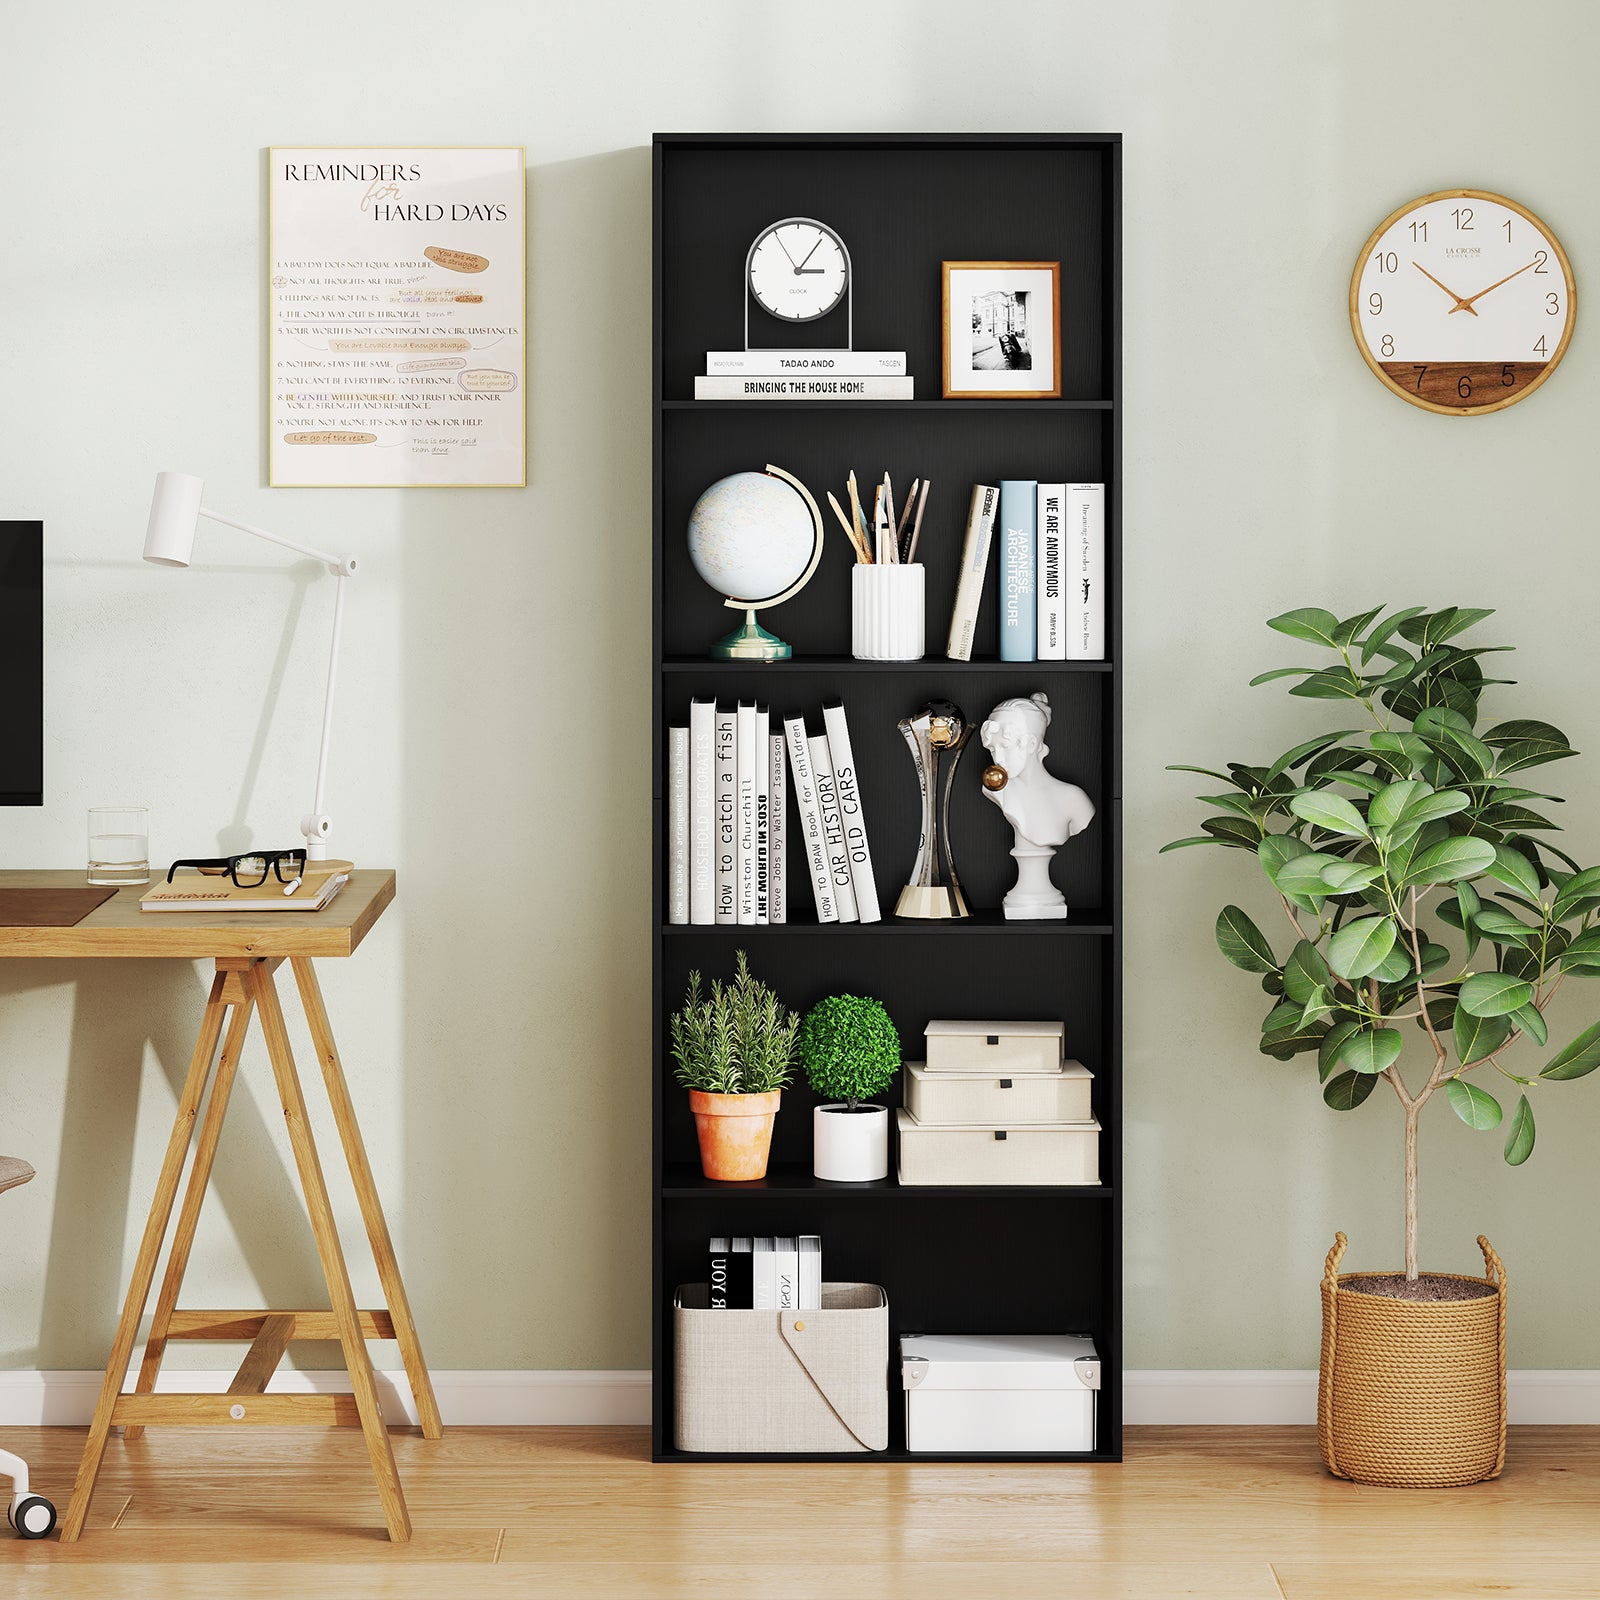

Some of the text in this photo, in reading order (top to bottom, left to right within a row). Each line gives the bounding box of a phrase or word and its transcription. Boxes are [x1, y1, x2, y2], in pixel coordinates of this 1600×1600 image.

[284, 164, 420, 181] REMINDERS
[360, 177, 402, 212] for
[374, 204, 508, 221] HARD DAYS
[1451, 208, 1474, 230] 12
[1409, 222, 1427, 242] 11
[1502, 220, 1511, 243] 1
[1375, 252, 1398, 273] 10
[1534, 250, 1548, 273] 2
[1369, 293, 1382, 315] 9
[1546, 292, 1559, 315] 3
[1381, 334, 1394, 357] 8
[1533, 335, 1548, 357] 4
[744, 382, 864, 393] BRINGING THE HOUSE HOME
[1413, 366, 1427, 389] 7
[1458, 376, 1472, 399] 6
[1501, 365, 1515, 387] 5
[1080, 504, 1090, 536] Dreaming
[1046, 498, 1058, 598] WE ARE ANONYMOUS
[1008, 528, 1028, 626] JAPANESE ARCHITECTURE
[697, 734, 709, 891] HOUSEHOLD DECORATES
[718, 722, 732, 915] How to catch a fish
[792, 724, 832, 918] HOW TO DRAW Book for children
[838, 767, 866, 863] OLD CARS
[675, 732, 685, 917] How to make an arrangement in the house
[817, 774, 849, 886] CAR HISTORY
[742, 778, 752, 914] Winston Churchill
[773, 837, 782, 850] by
